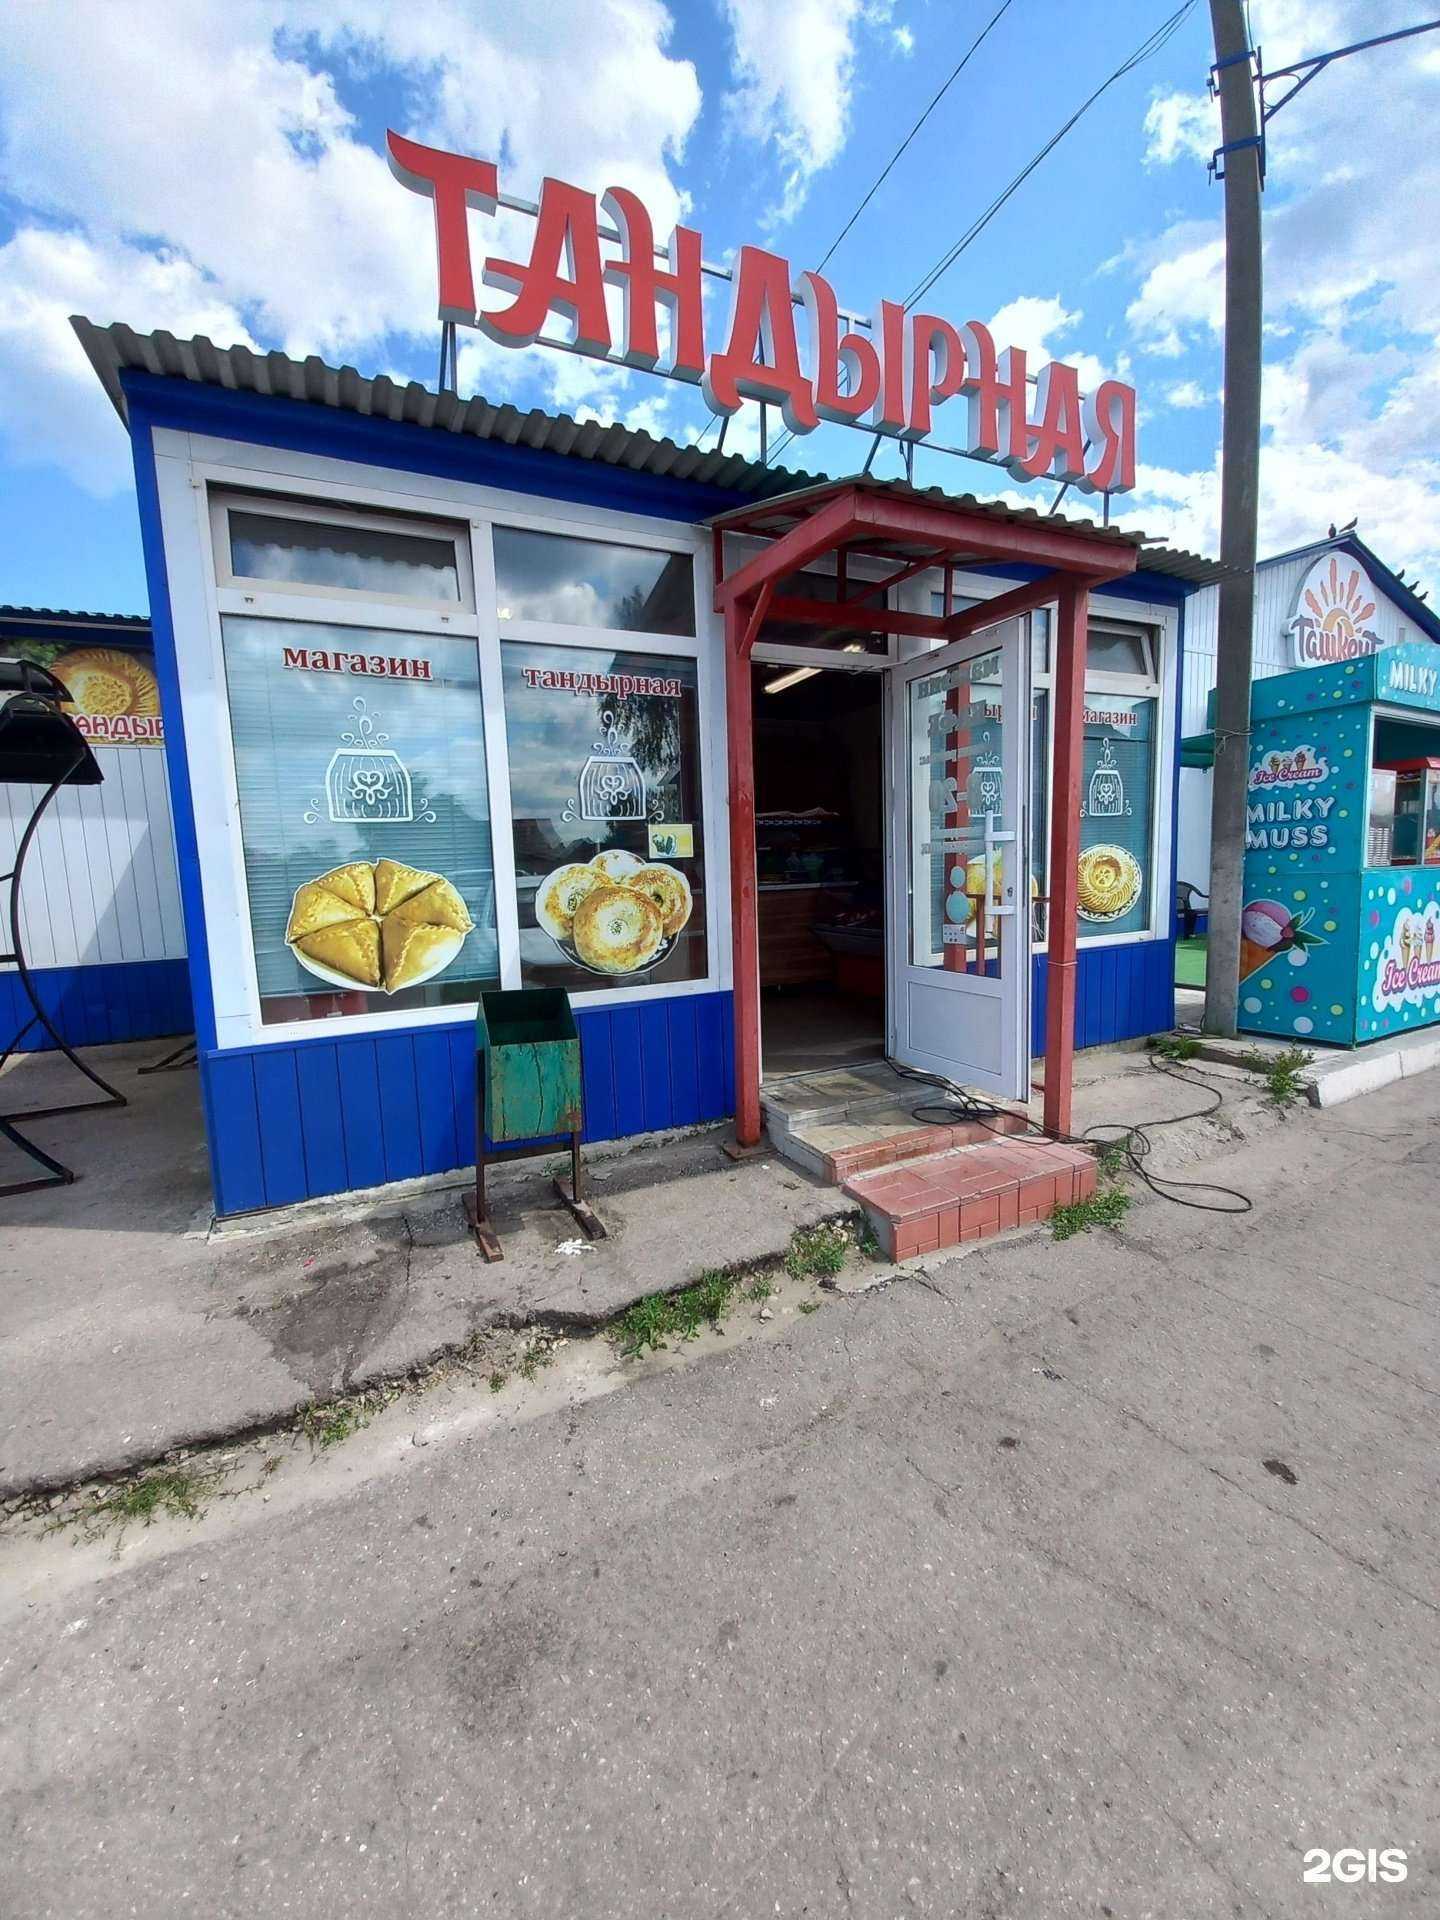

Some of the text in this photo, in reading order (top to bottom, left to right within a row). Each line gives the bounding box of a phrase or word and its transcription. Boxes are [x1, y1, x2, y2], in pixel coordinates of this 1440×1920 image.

[386, 128, 1136, 494] ТАНДЫРНАЯ
[282, 647, 433, 680] магазин
[1389, 660, 1438, 697] MILKY
[522, 667, 682, 700] тандырная
[74, 715, 164, 740] АНДЫР
[1253, 767, 1322, 784] Ice Cream
[1247, 797, 1335, 824] MILKY
[1246, 825, 1328, 849] MUSS
[1382, 959, 1407, 995] Ice
